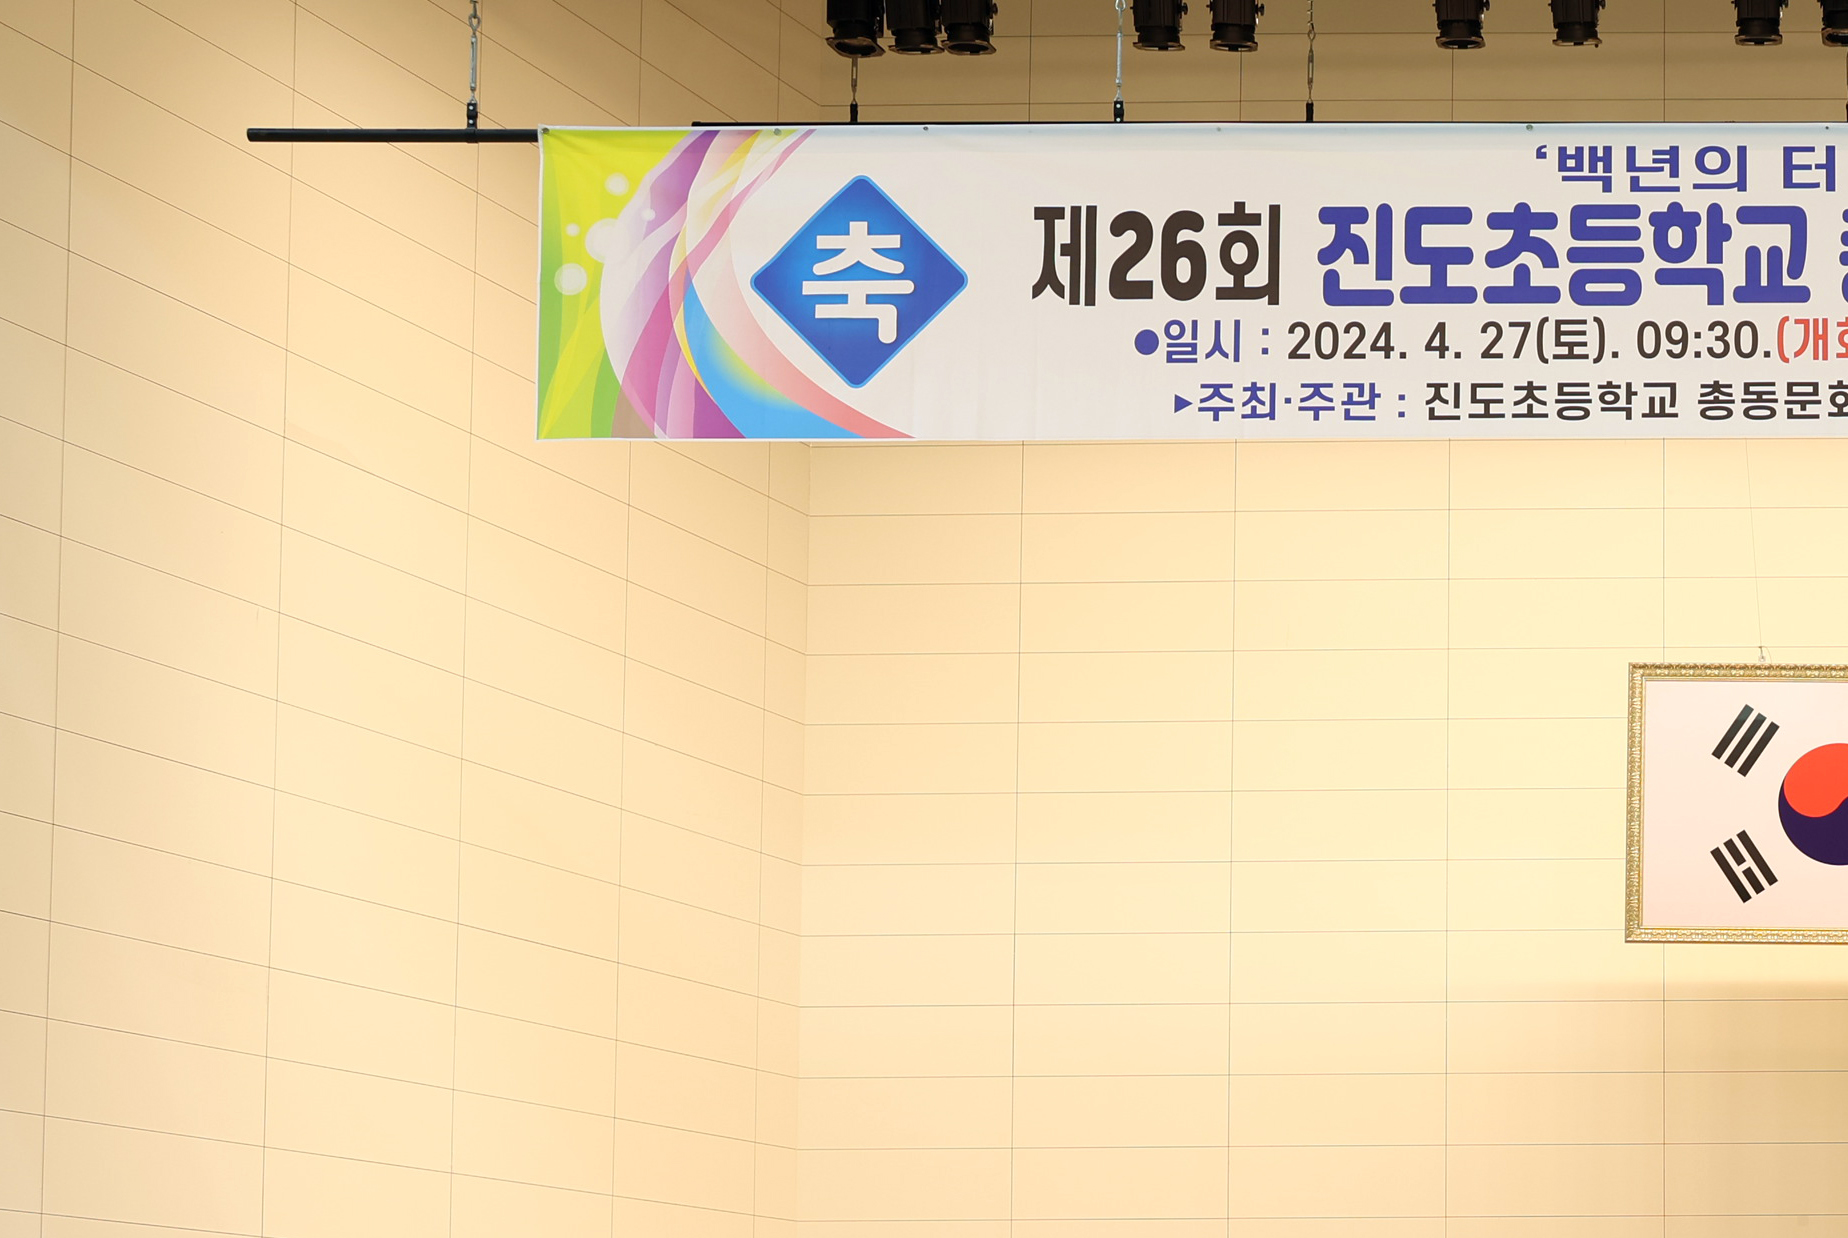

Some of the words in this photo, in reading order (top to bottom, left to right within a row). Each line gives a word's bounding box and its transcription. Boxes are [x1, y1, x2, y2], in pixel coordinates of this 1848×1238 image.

[1783, 145, 1835, 192] 터
[1032, 201, 1280, 306] 제26회
[1317, 202, 1811, 306] 진도초등학교
[802, 220, 914, 345] 축
[1288, 321, 1406, 360] 2024.
[1425, 322, 1461, 359] 4.
[1481, 316, 1618, 364] 27(토).
[1426, 381, 1678, 421] 진도초등학교
